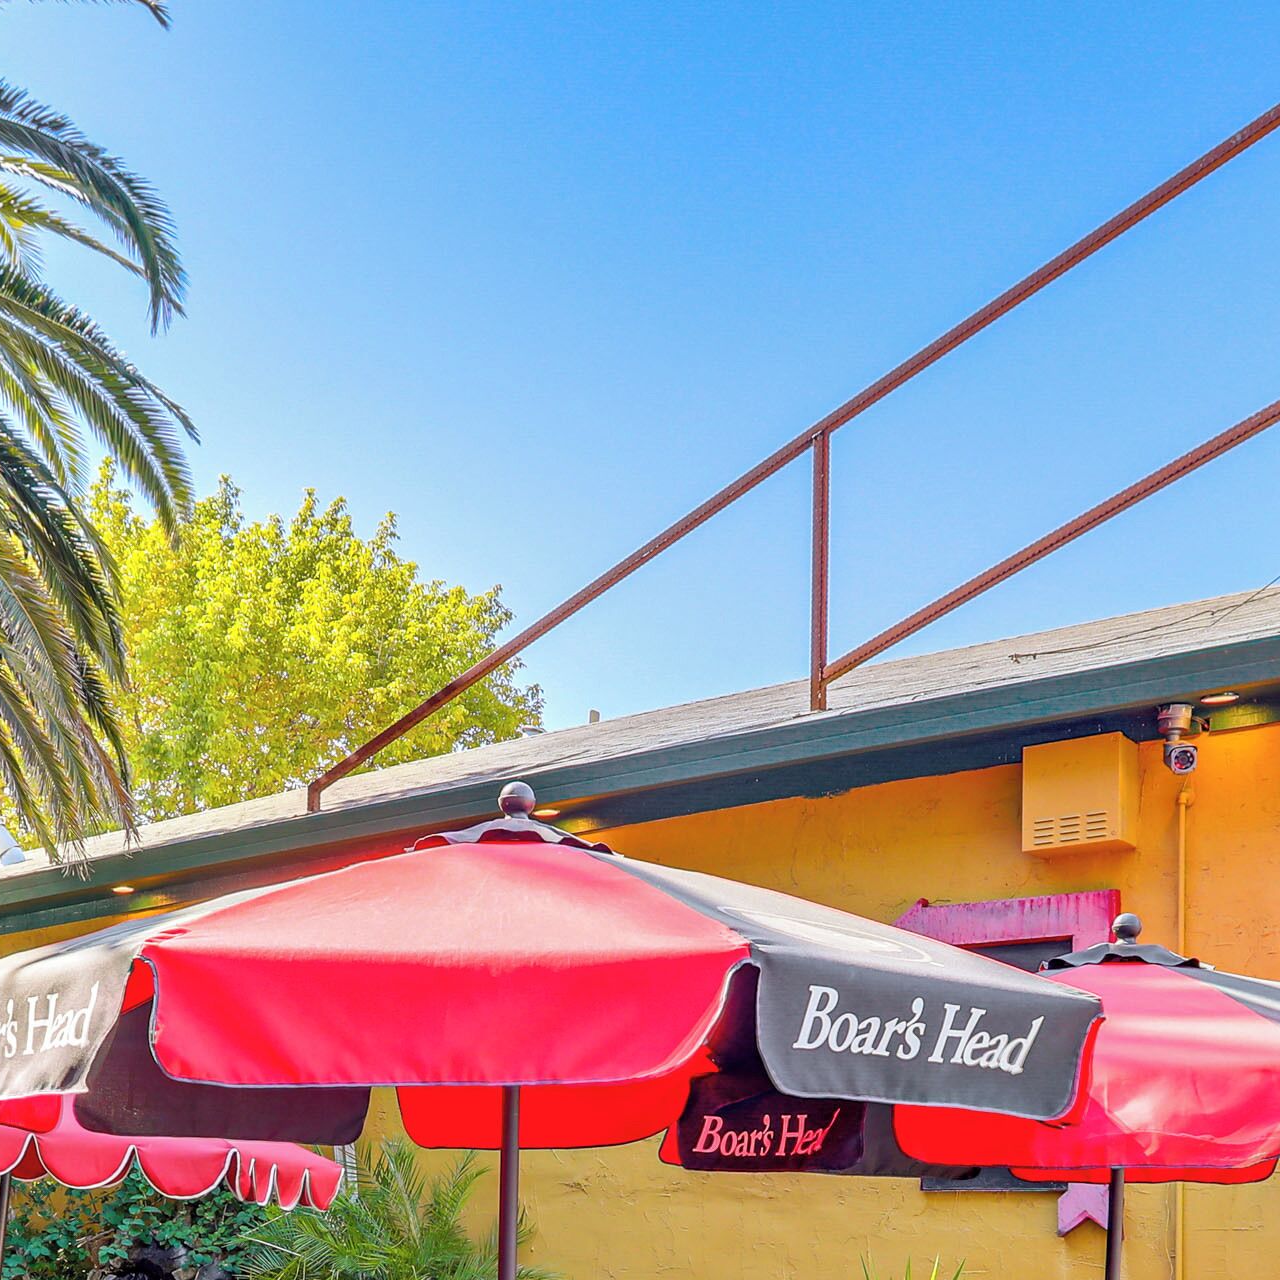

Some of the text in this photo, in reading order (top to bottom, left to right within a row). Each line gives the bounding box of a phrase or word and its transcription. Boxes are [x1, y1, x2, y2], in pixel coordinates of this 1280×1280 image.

[22, 981, 100, 1056] Head
[792, 984, 1045, 1076] Boar's Head
[692, 1114, 774, 1157] Boar's
